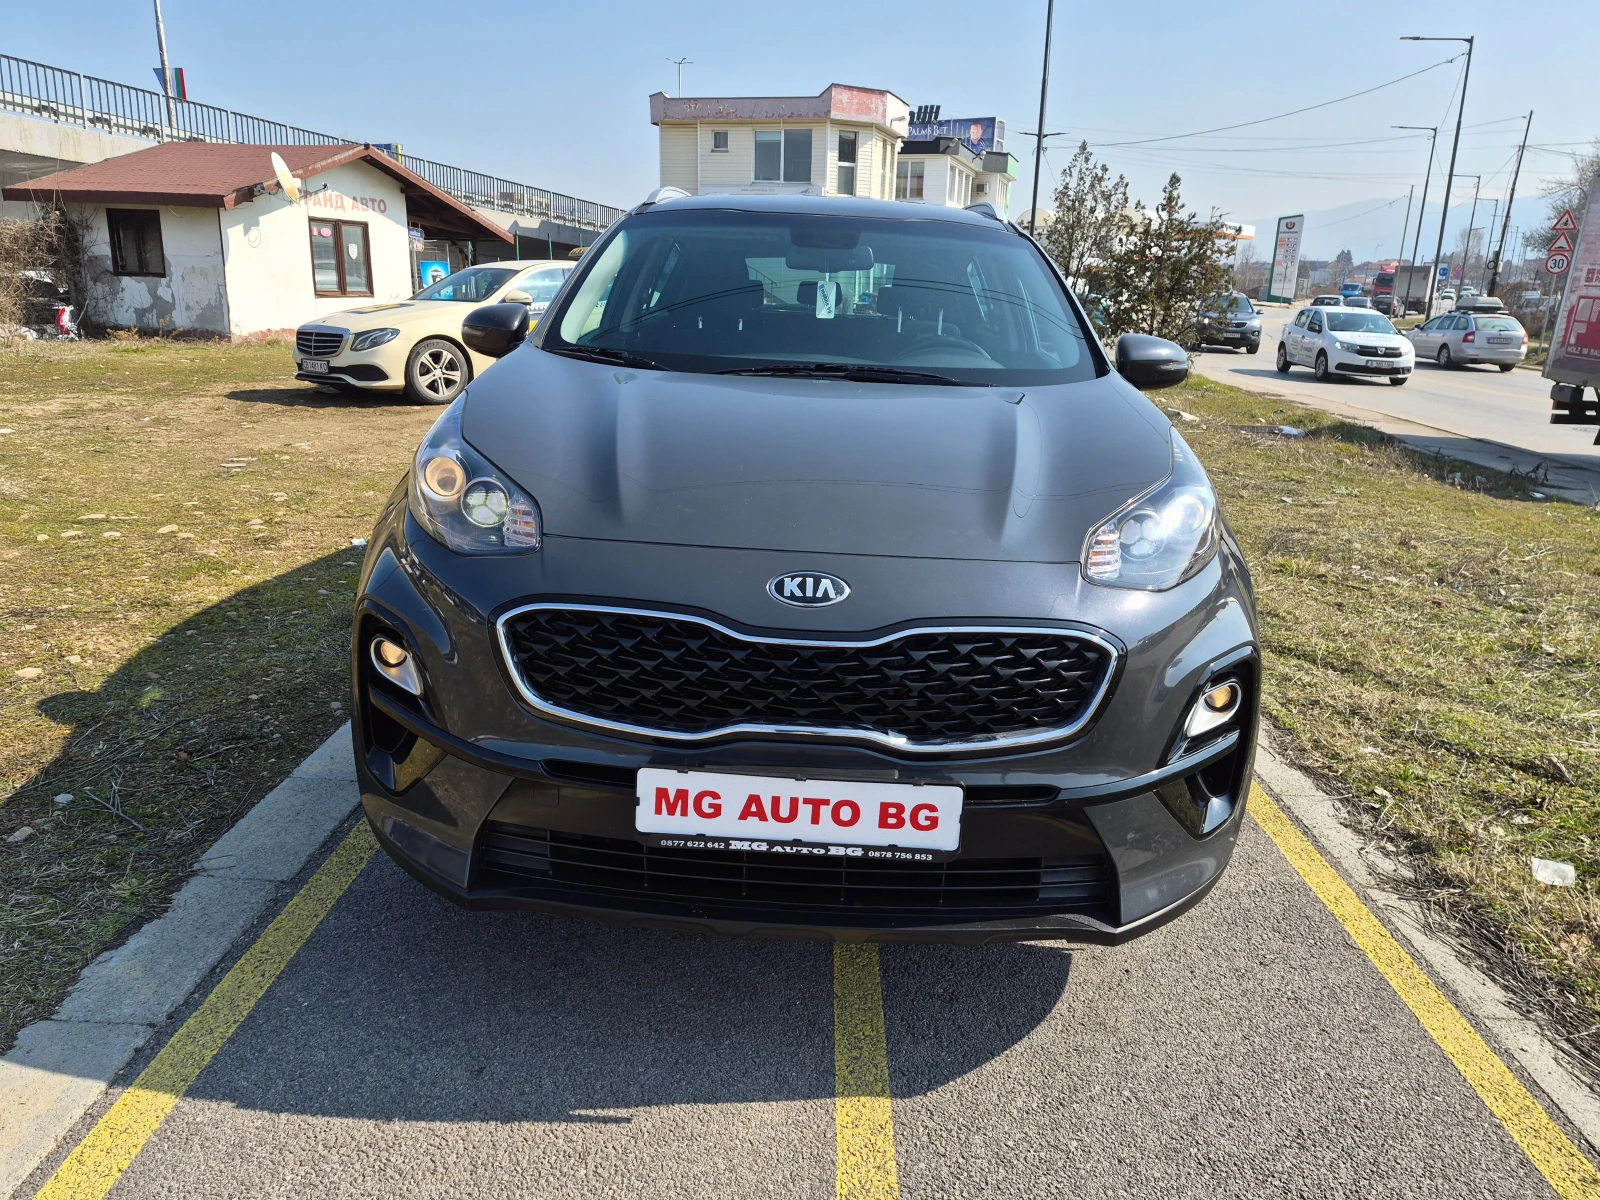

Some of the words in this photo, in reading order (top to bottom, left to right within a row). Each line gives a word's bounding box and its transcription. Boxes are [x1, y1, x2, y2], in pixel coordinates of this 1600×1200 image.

[933, 125, 948, 136] BET
[351, 196, 387, 213] АВТО
[1550, 258, 1565, 270] 30
[783, 577, 837, 599] KIA
[654, 786, 723, 820] MG
[737, 793, 861, 828] AUTO
[877, 801, 940, 832] BG
[660, 839, 685, 847] 0877
[687, 840, 705, 848] 622
[706, 841, 725, 849] 642
[728, 840, 770, 852] MG
[827, 845, 865, 857] BG
[868, 850, 893, 859] 0878
[894, 851, 913, 860] 756
[914, 852, 934, 861] 853
